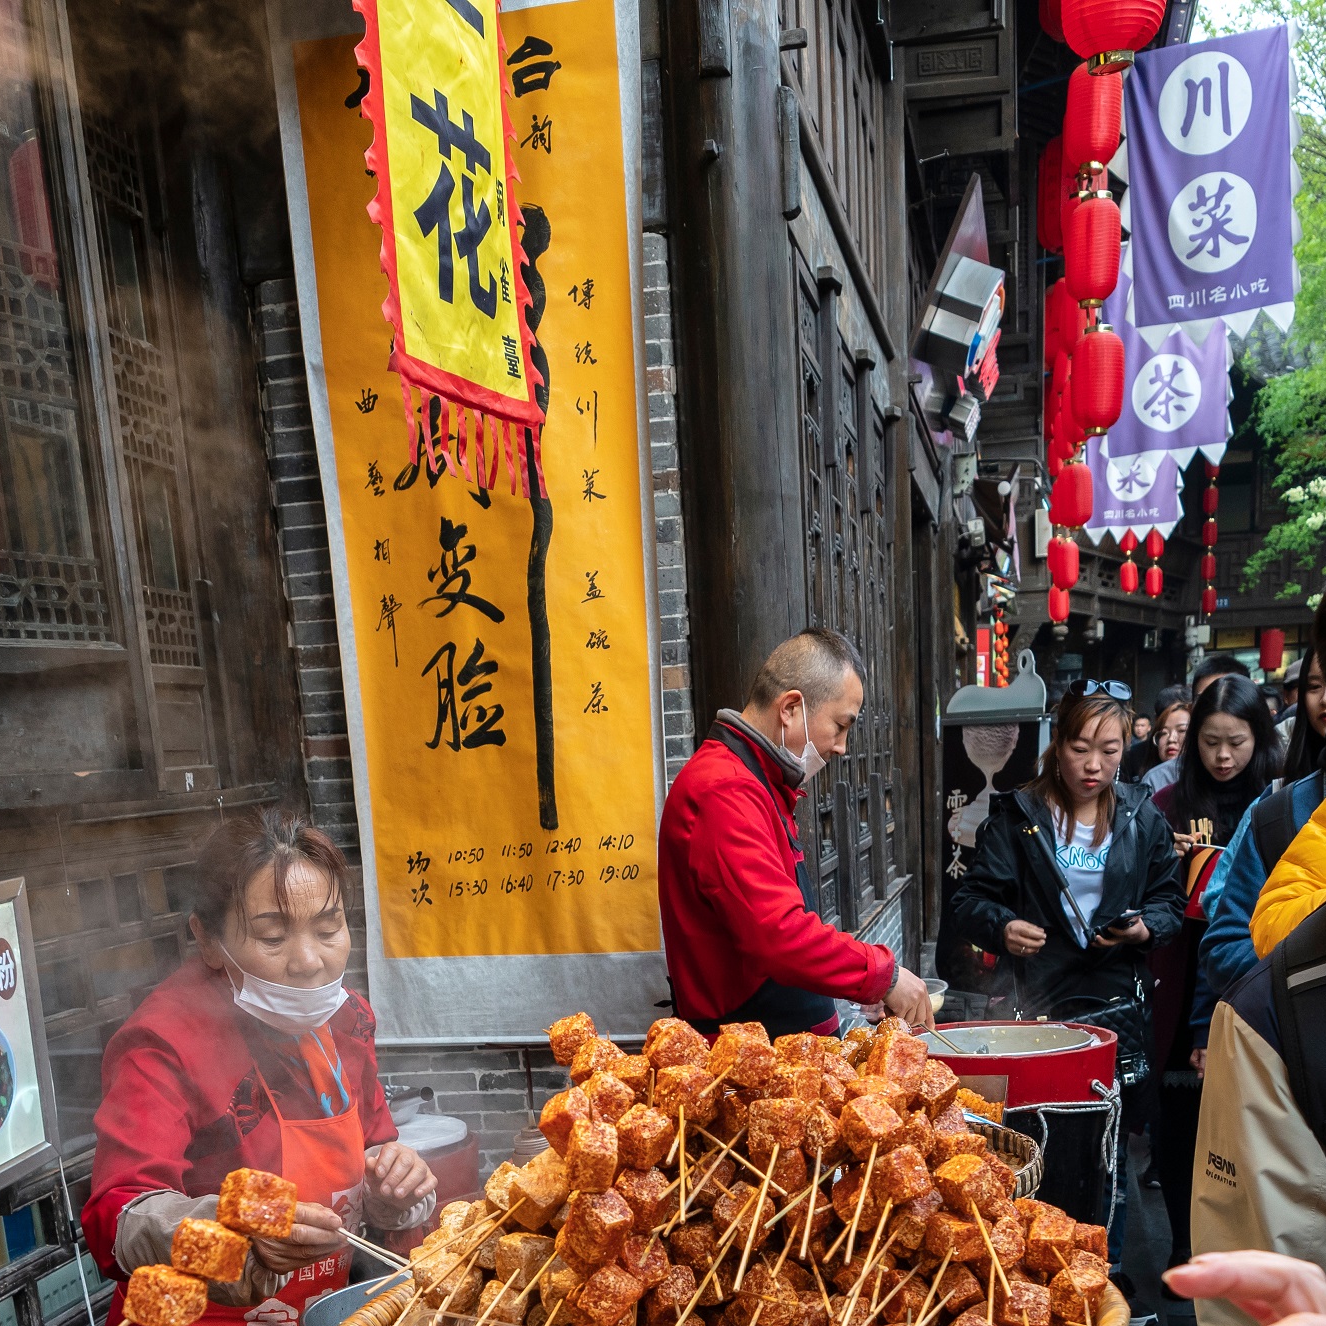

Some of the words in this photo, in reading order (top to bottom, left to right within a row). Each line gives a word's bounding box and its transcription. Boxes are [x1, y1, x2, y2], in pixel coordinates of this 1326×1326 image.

[411, 0, 497, 320] 花
[1180, 62, 1250, 259] 川菜
[1167, 277, 1270, 310] 四川名小吃
[1143, 360, 1195, 425] 茶
[1103, 507, 1160, 520] 四川名小吃
[448, 847, 485, 865] 10:50
[501, 842, 533, 859] 11:50
[545, 837, 582, 855] 12:40
[598, 834, 635, 852] 14:10
[449, 878, 488, 898] 15:30
[501, 874, 534, 893] 16:40
[546, 869, 585, 889] 17:30
[599, 864, 639, 884] 19:00
